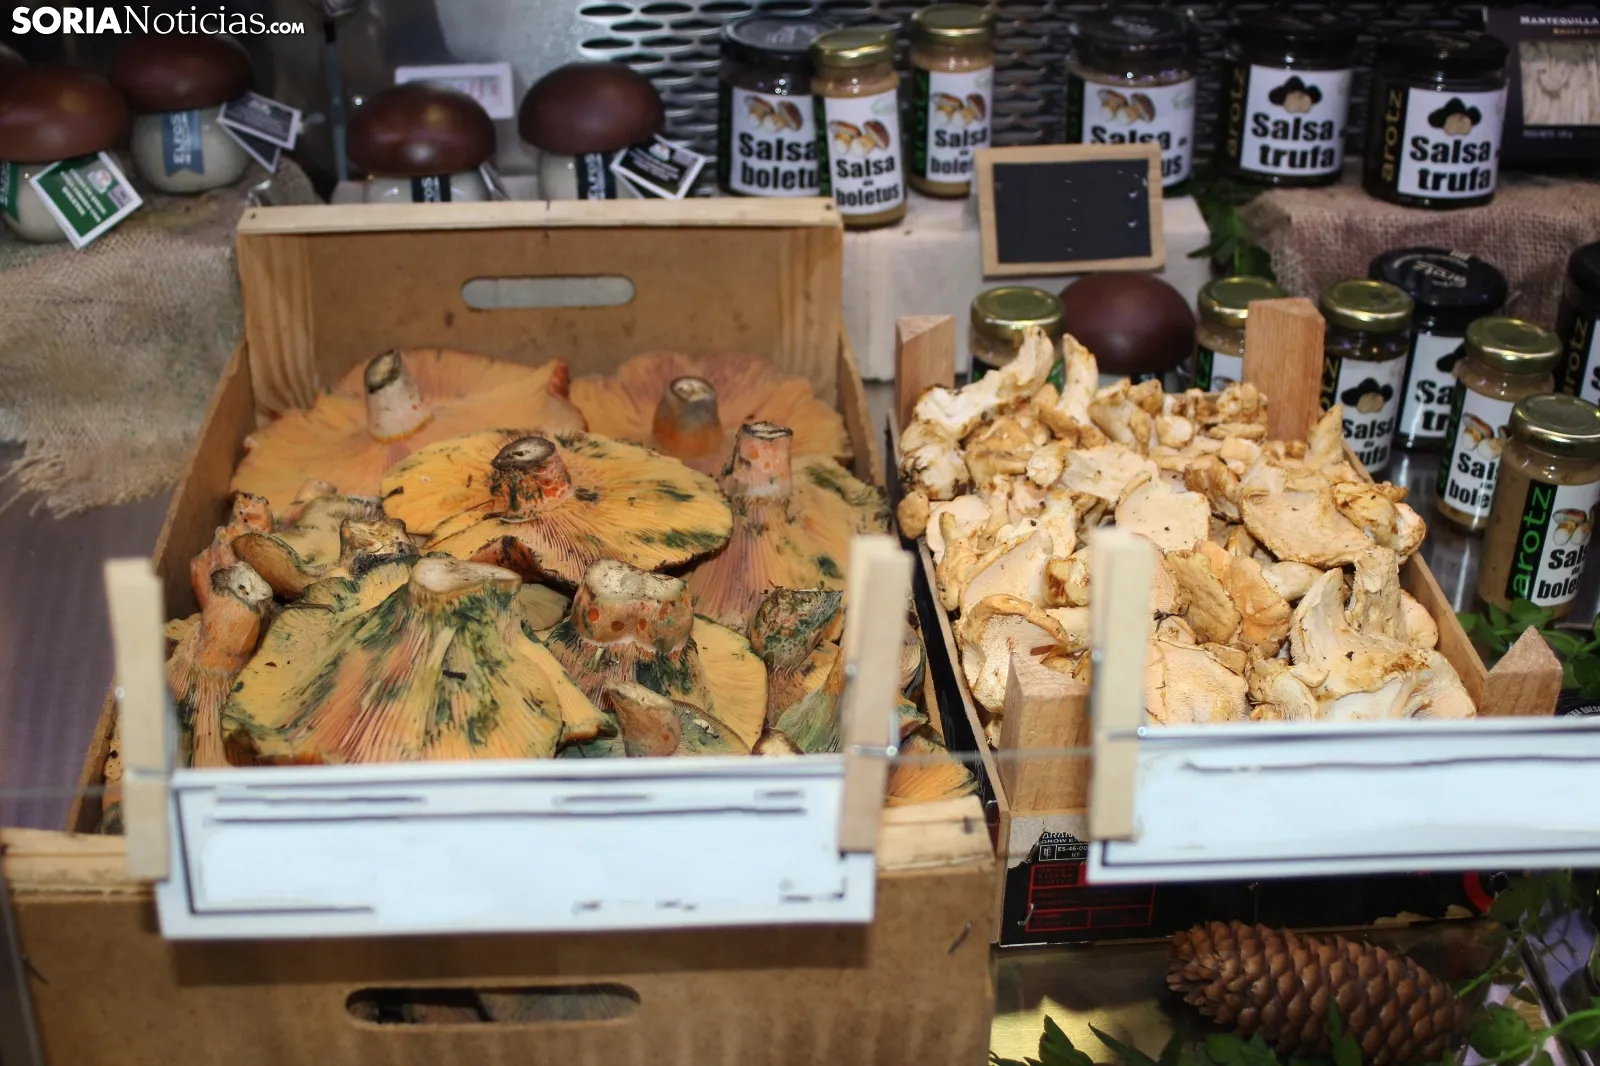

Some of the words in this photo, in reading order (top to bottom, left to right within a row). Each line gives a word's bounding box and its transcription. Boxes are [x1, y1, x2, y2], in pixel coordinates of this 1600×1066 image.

[1252, 111, 1334, 142] Salsa
[739, 131, 817, 162] Salsa
[1259, 144, 1335, 169] trufa
[1409, 135, 1491, 164] Salsa
[836, 155, 895, 179] Salsa
[1417, 167, 1491, 192] trufa
[836, 183, 899, 207] boletus
[1513, 486, 1552, 599] arotz
